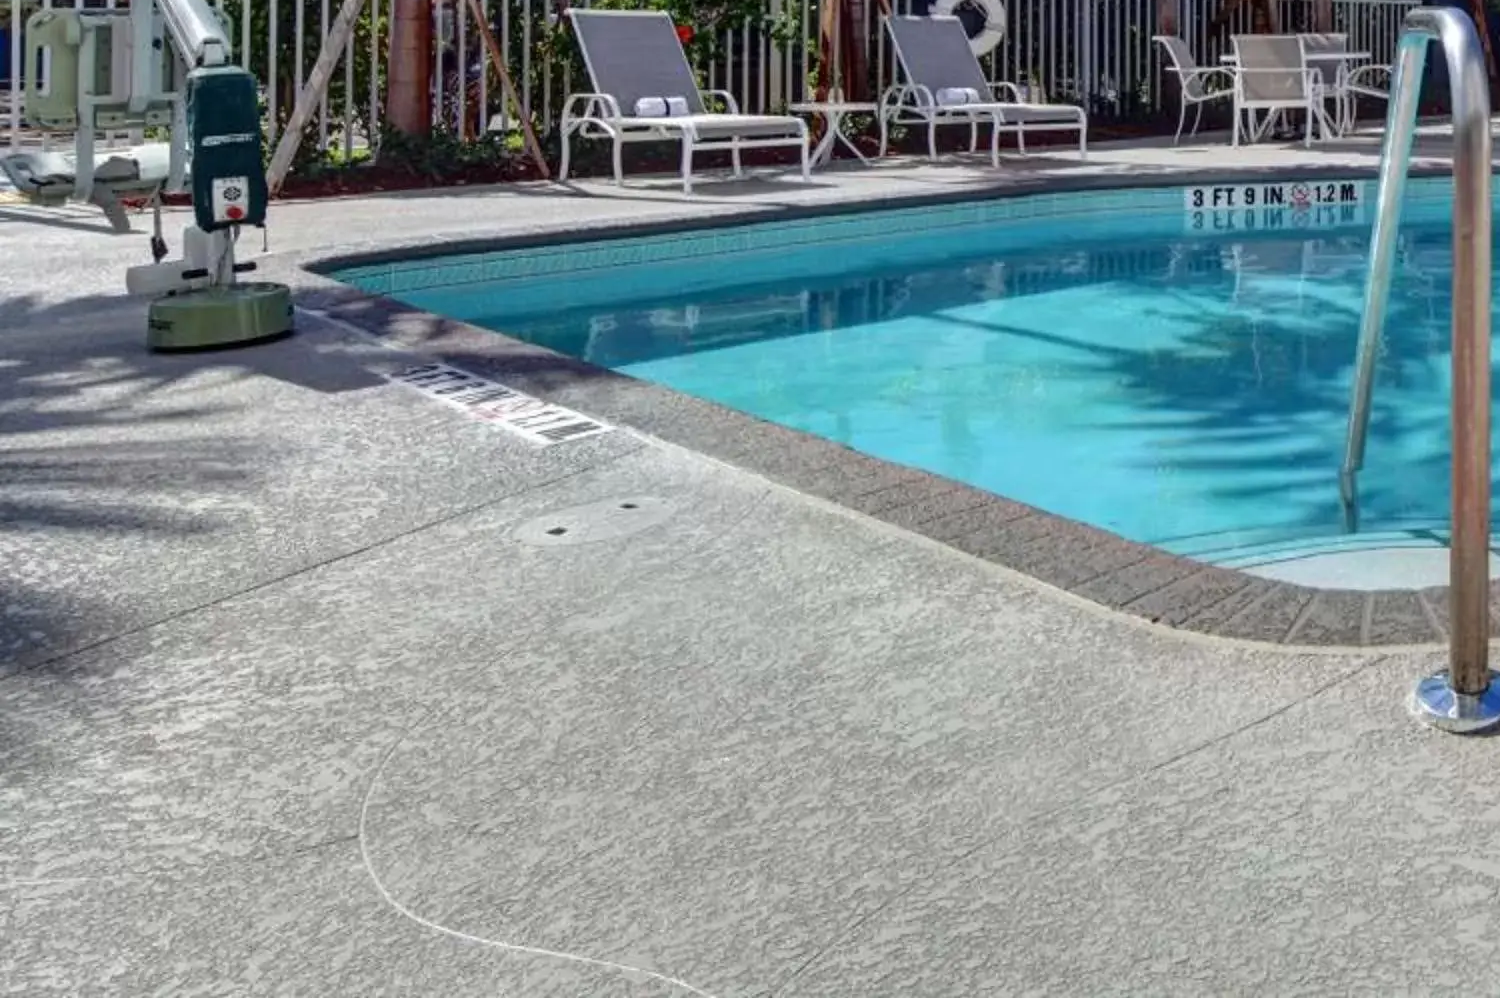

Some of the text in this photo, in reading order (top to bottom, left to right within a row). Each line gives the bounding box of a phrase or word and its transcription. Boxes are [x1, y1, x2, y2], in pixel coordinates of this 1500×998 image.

[1192, 189, 1204, 207] 3
[1245, 187, 1255, 205] 9
[1315, 183, 1335, 202] 1.2
